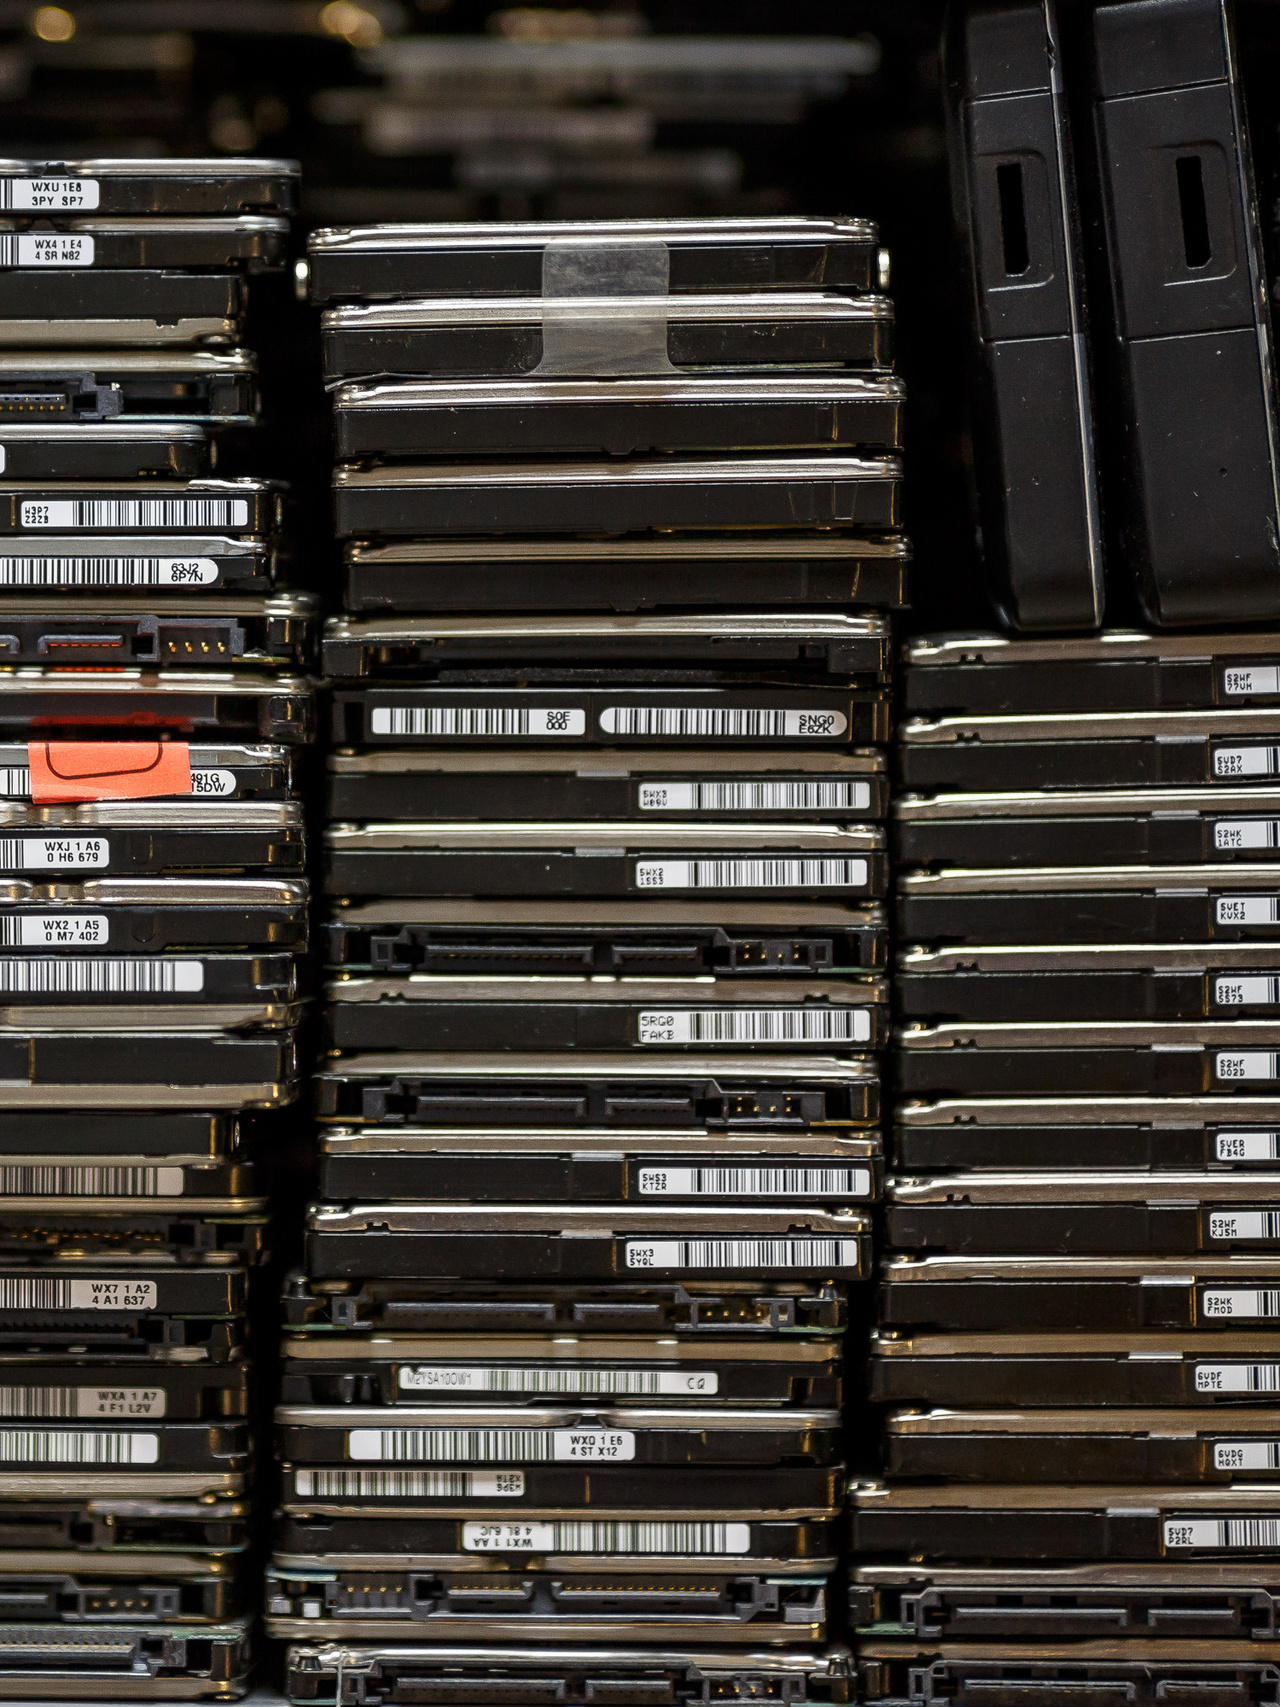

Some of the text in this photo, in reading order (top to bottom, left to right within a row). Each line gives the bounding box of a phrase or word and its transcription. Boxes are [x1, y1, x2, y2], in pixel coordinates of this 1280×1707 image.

[31, 182, 59, 192] WXU
[31, 196, 84, 206] 3PY SP7
[35, 239, 82, 249] WX4 1 E4
[35, 251, 80, 260] 4 SR N82
[25, 506, 48, 515] W3P7
[171, 563, 199, 573] 63J2
[171, 572, 203, 582] 6P7N
[1227, 674, 1251, 683] S2WF
[799, 724, 832, 734] E6ZK
[1217, 756, 1242, 765] 5VD7
[643, 790, 667, 798] 5WX3
[1217, 829, 1242, 838] S2WK
[45, 841, 100, 852] WXJ 1 A6
[1218, 838, 1242, 847] 1ATC
[59, 853, 74, 862] H6
[78, 852, 99, 862] 679
[640, 868, 664, 877] 5WX2
[1220, 903, 1245, 911] 5VET
[1220, 911, 1246, 920] KVX2
[43, 920, 99, 930] WX2 1 A5
[57, 932, 74, 941] M7
[78, 931, 99, 941] 402
[1218, 986, 1243, 994] S2WF
[1220, 1059, 1245, 1068] S2WF
[1220, 1140, 1245, 1148] 5VER
[642, 1173, 667, 1182] 5WS3
[642, 1182, 667, 1190] KTZR
[1212, 1220, 1236, 1228] S2WF
[630, 1249, 654, 1257] 5WX3
[91, 1284, 150, 1294] WX7 1 A2
[92, 1296, 146, 1305] 4 A1 637
[1207, 1297, 1232, 1306] S2WK
[1198, 1372, 1222, 1380] 6VDF
[1198, 1380, 1222, 1389] MPTE
[98, 1392, 157, 1401] WXA 1 A7
[98, 1404, 151, 1413] 4 F1 L2V
[601, 1436, 606, 1445] 1
[610, 1436, 623, 1445] E6
[570, 1447, 618, 1456] 4 ST X12
[1218, 1450, 1243, 1458] 6VDG
[497, 1483, 521, 1492] W3P6
[525, 1527, 532, 1535] 4
[1168, 1528, 1193, 1536] 5VD7
[473, 1538, 533, 1547] WX1 1 AA
[1168, 1536, 1193, 1545] P2RL
